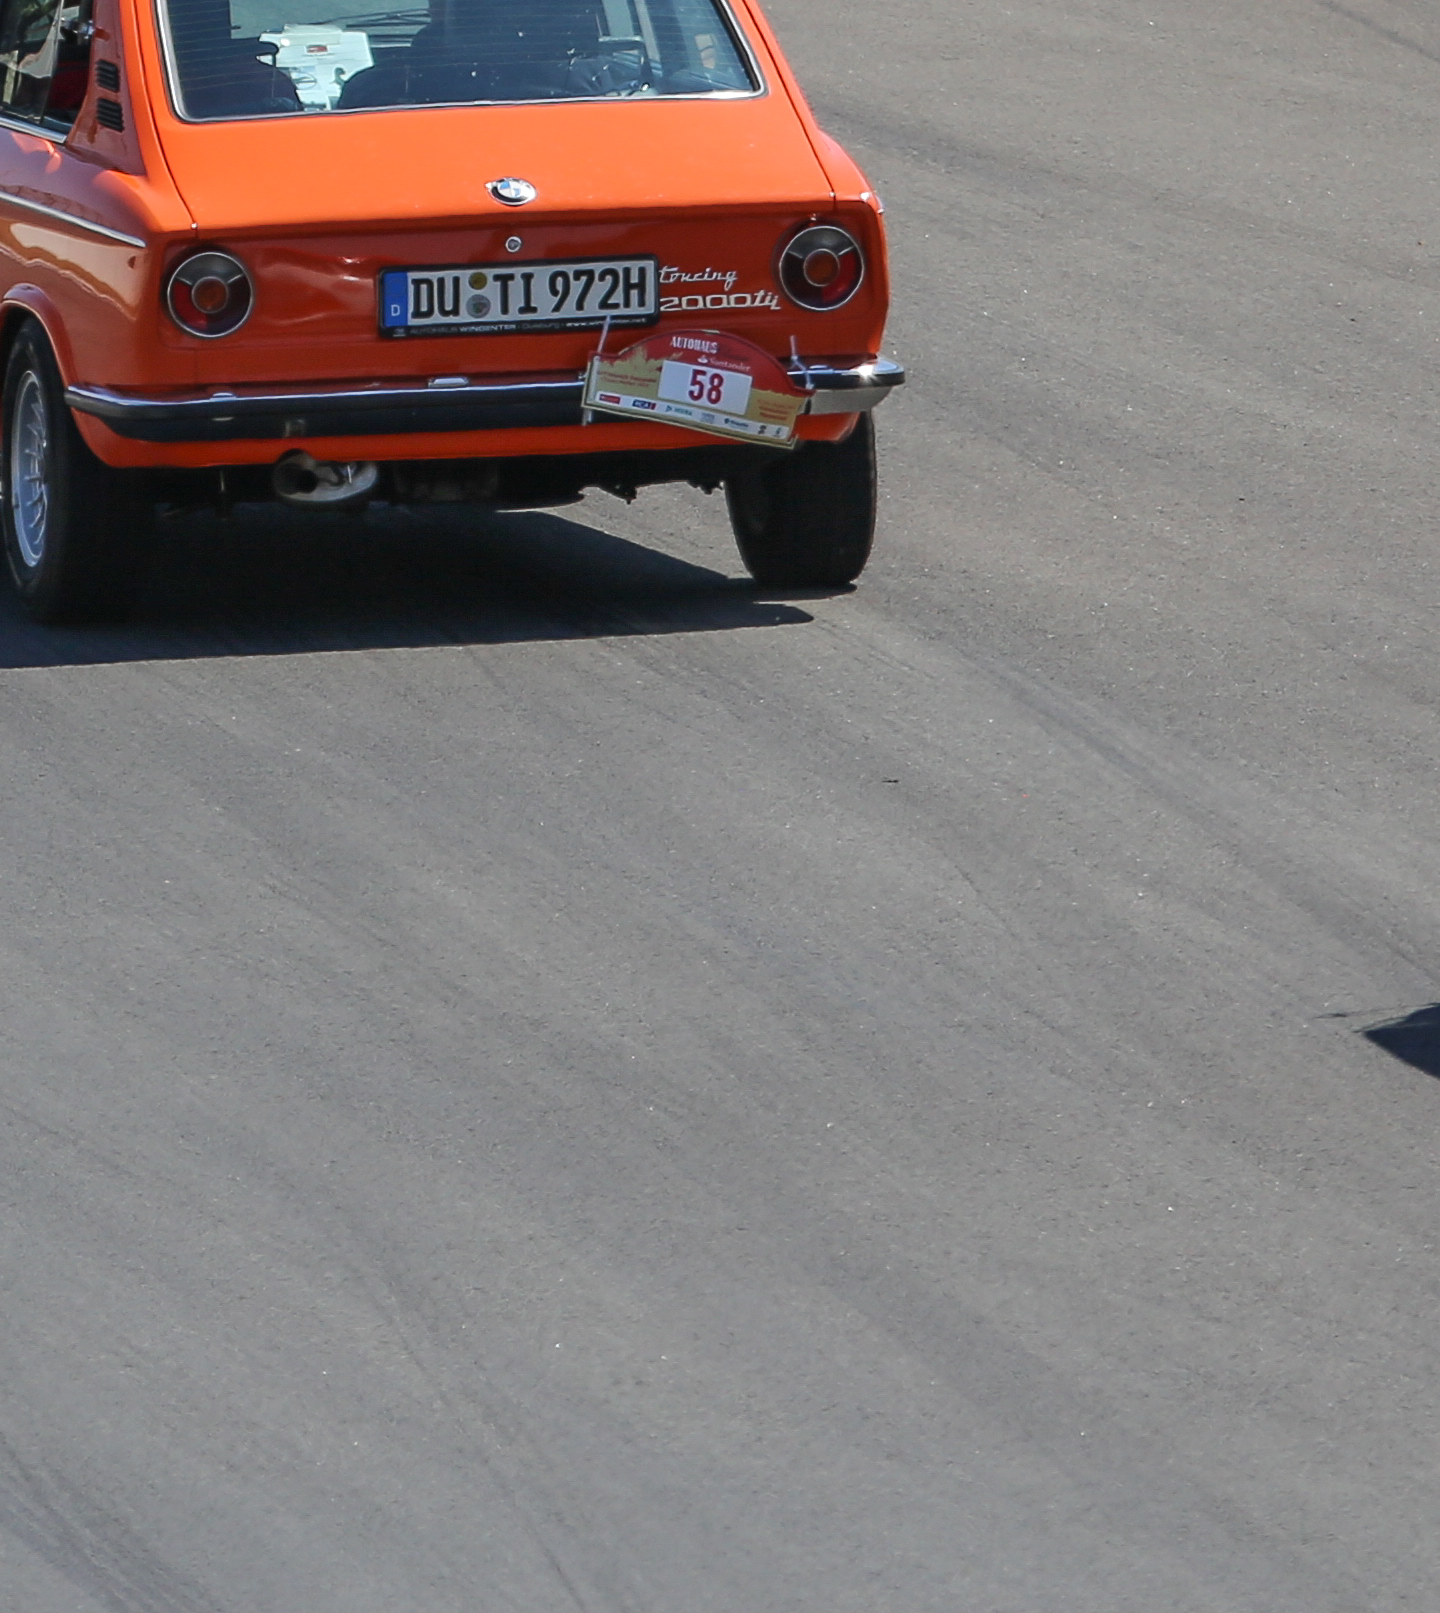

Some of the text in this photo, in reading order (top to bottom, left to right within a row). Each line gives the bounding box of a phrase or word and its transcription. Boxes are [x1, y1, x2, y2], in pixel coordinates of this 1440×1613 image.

[391, 266, 647, 319] D DU TI 972H
[670, 336, 718, 354] AUTOHAUS
[688, 369, 724, 404] 58
